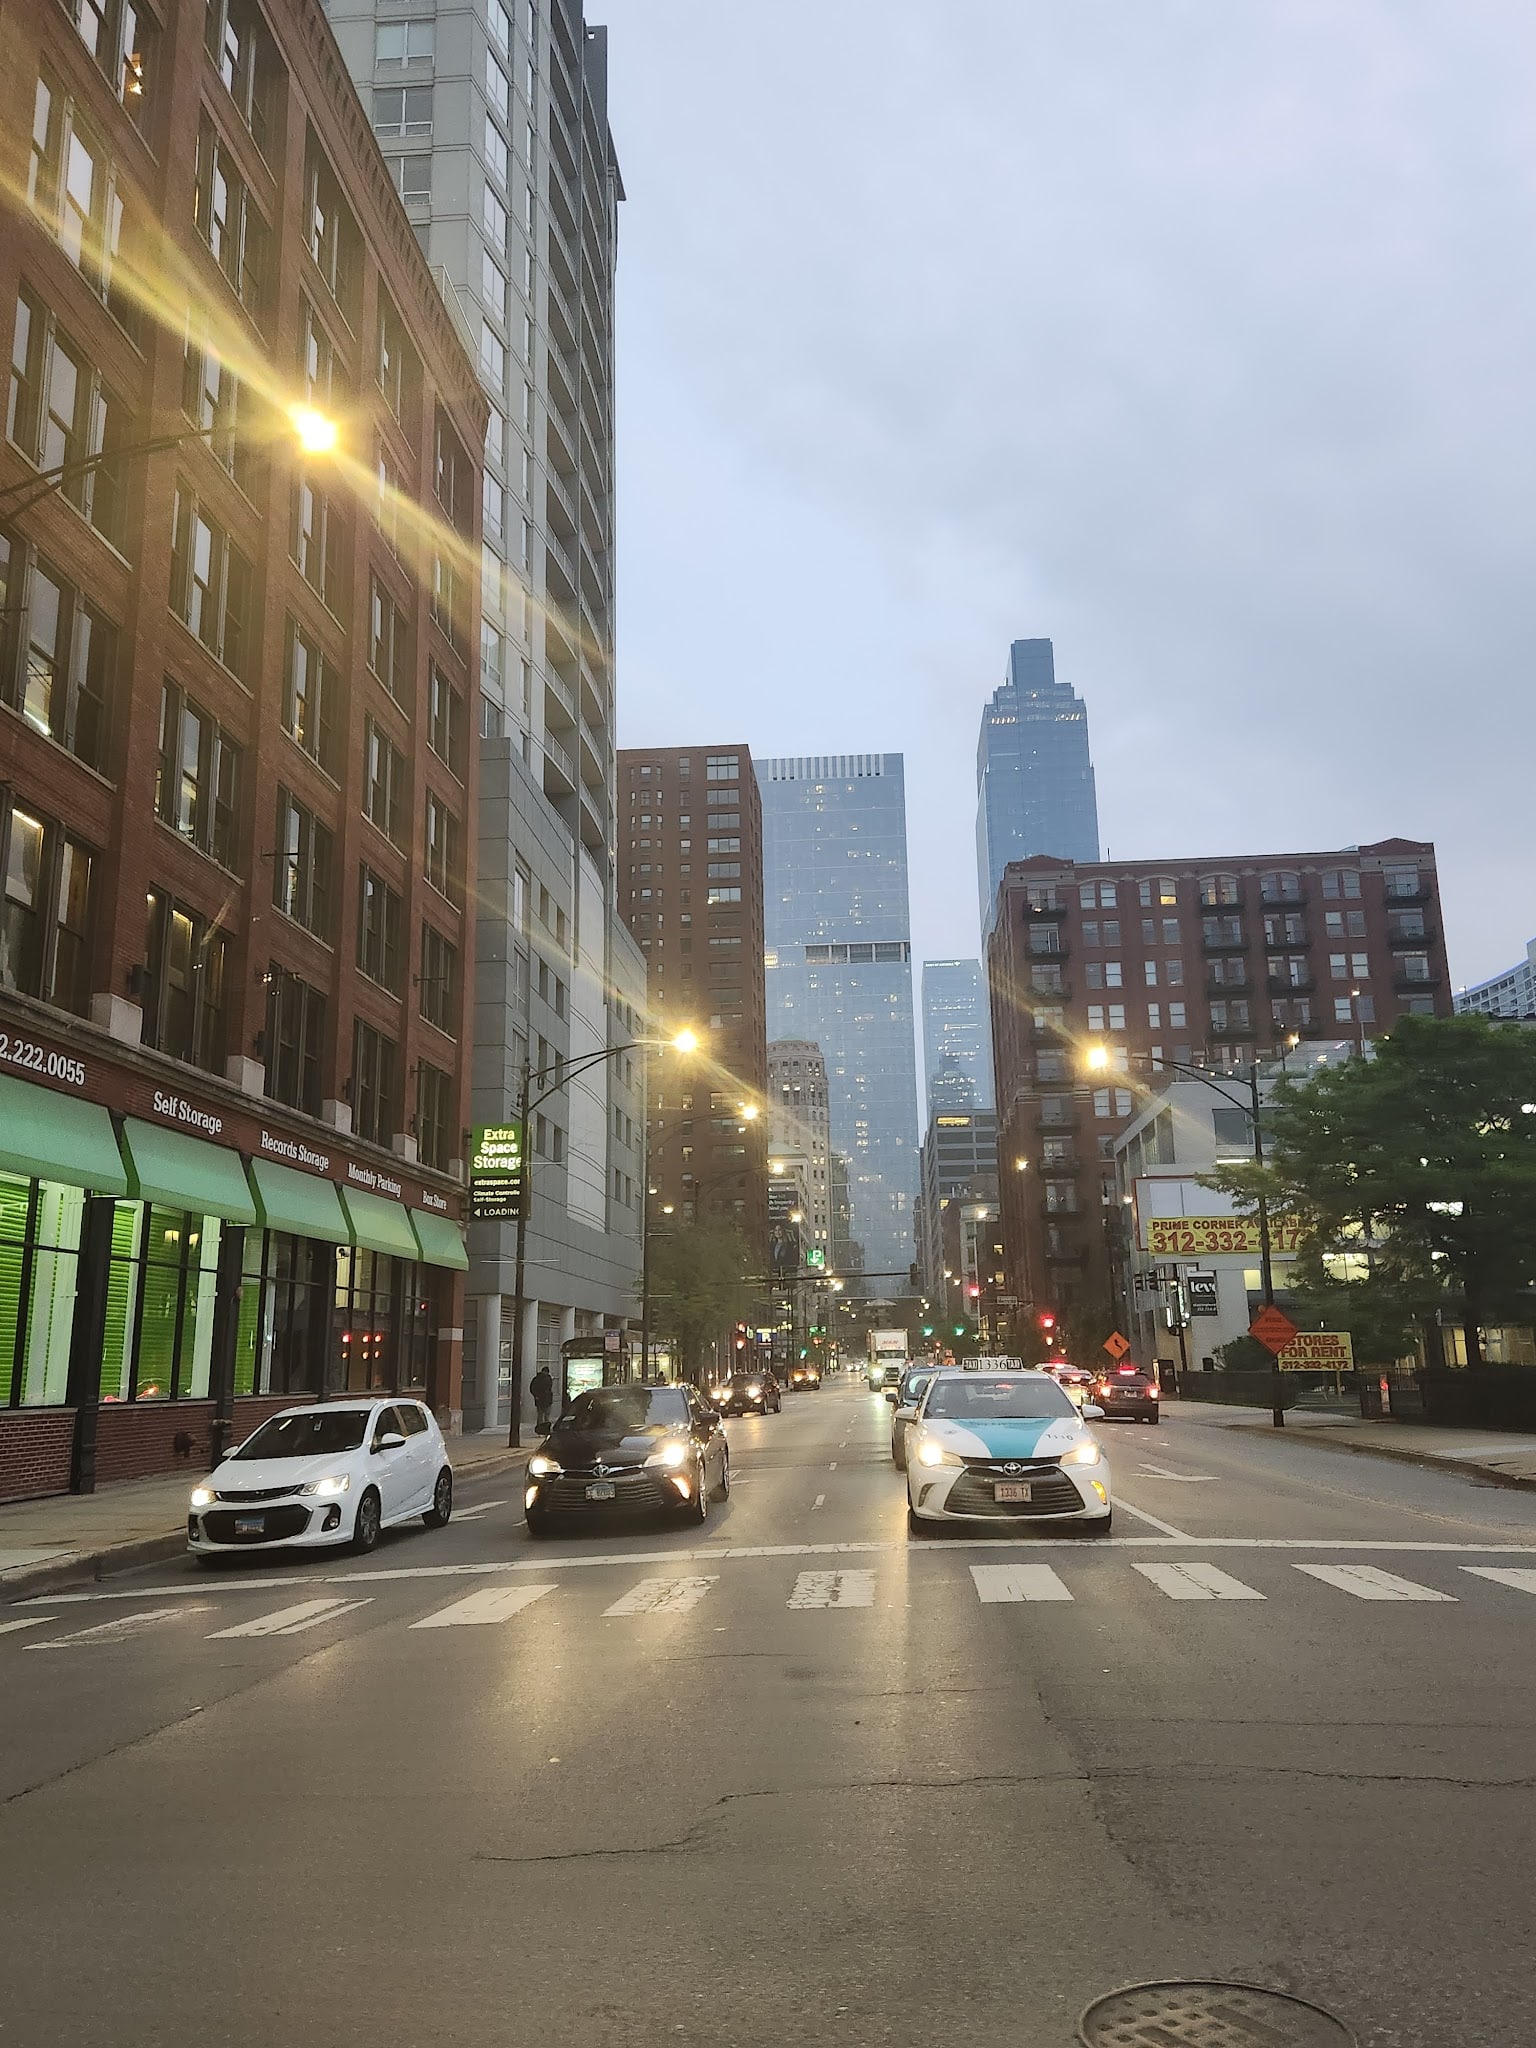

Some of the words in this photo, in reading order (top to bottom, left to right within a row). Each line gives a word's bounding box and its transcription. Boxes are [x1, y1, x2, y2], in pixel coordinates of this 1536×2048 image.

[153, 1090, 178, 1117] Self
[178, 1100, 222, 1135] Storage
[483, 1128, 515, 1140] Extra
[261, 1130, 298, 1159] Records
[298, 1144, 329, 1171] Storage
[480, 1141, 518, 1156] Space
[348, 1162, 376, 1189] Monthly
[376, 1174, 402, 1198] Parking
[422, 1190, 433, 1206] Box
[1152, 1221, 1189, 1231] PRIME
[1193, 1220, 1242, 1229] CORNER
[1153, 1231, 1309, 1252] 312-332-17
[1281, 1347, 1307, 1358] FOR
[1312, 1347, 1346, 1358] RENT
[980, 1359, 1007, 1370] 1336
